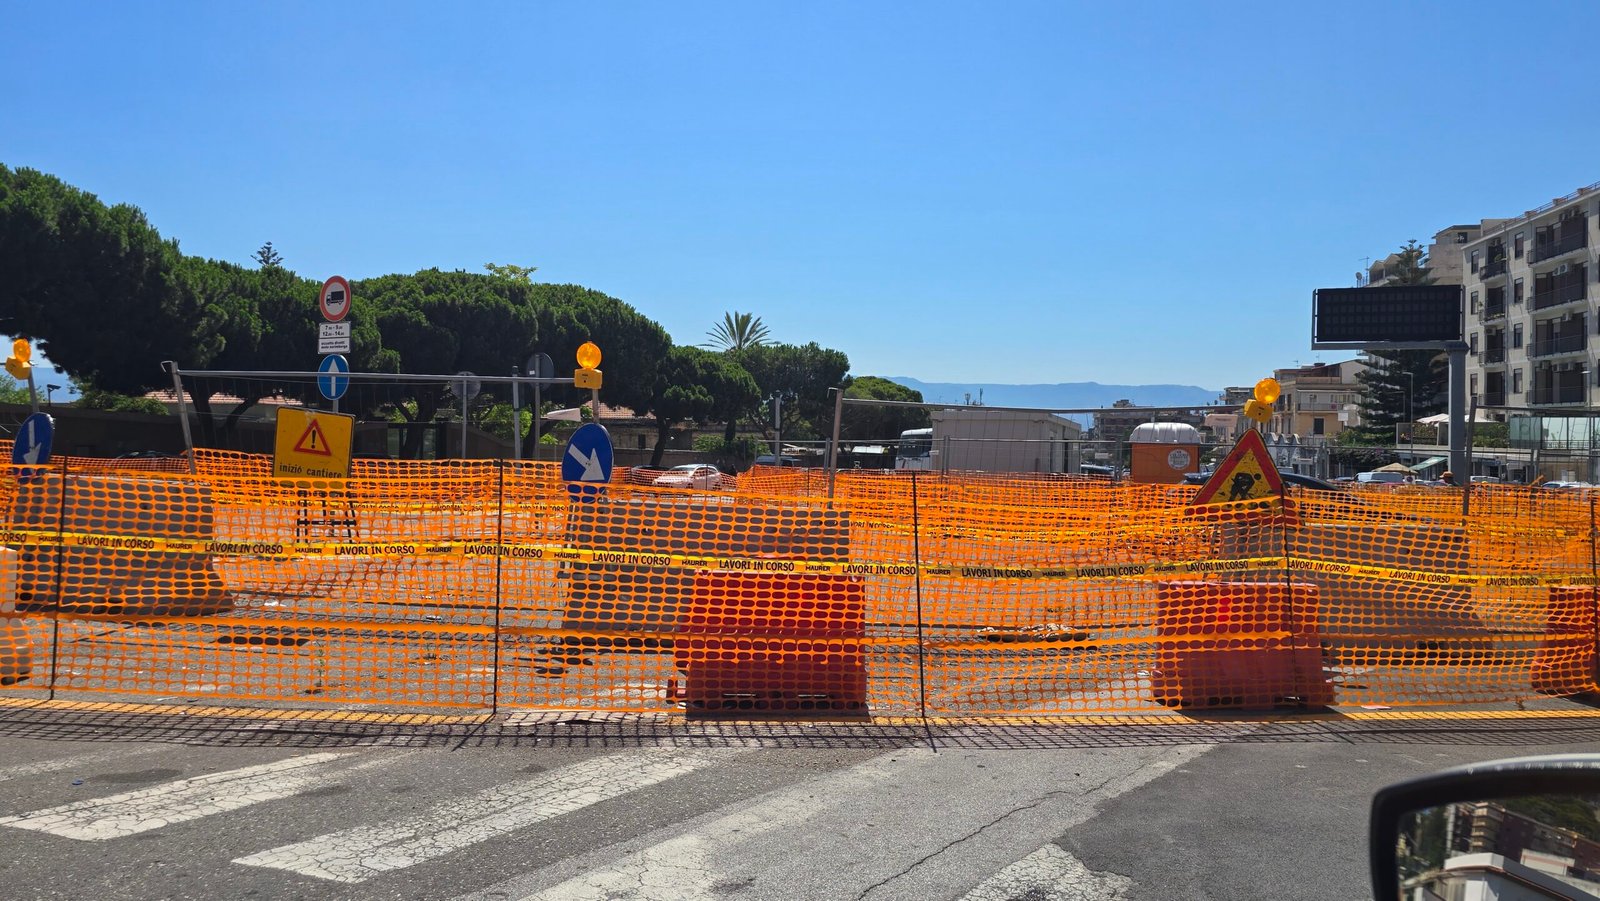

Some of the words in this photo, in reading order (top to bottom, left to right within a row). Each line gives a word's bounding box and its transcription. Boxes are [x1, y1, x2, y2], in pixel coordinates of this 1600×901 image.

[77, 536, 109, 547] LAVORI
[110, 538, 122, 548] IN
[124, 540, 155, 549] CORSO
[204, 543, 239, 553] LAVORI
[240, 544, 251, 553] IN
[252, 544, 283, 554] CORSO
[334, 546, 368, 555] LAVORI
[372, 545, 382, 554] IN
[384, 546, 415, 555] CORSO
[464, 545, 497, 555] LAVORI
[499, 546, 509, 556] IN
[513, 547, 543, 558] CORSO
[592, 553, 626, 563] LAVORI
[628, 554, 638, 564] IN
[641, 555, 670, 566] CORSO
[719, 560, 750, 570] LAVORI
[753, 561, 764, 570] IN
[766, 561, 794, 571] CORSO
[842, 564, 873, 574] LAVORI
[876, 565, 885, 574] IN
[888, 566, 916, 575] CORSO
[1186, 562, 1213, 571] LAVORI
[1215, 562, 1224, 570] IN
[1226, 561, 1248, 570] CORSO
[1288, 560, 1312, 570] LAVORI
[1314, 562, 1324, 571] IN
[1325, 564, 1350, 573] CORSO
[962, 568, 991, 577] LAVORI
[994, 569, 1003, 578] IN
[1006, 569, 1032, 578] CORSO
[1076, 568, 1105, 577] LAVORI
[1107, 568, 1116, 576] IN
[1119, 566, 1144, 576] CORSO
[1389, 570, 1415, 580] LAVORI
[1428, 575, 1450, 583] CORSO
[1519, 578, 1538, 586] CORSO
